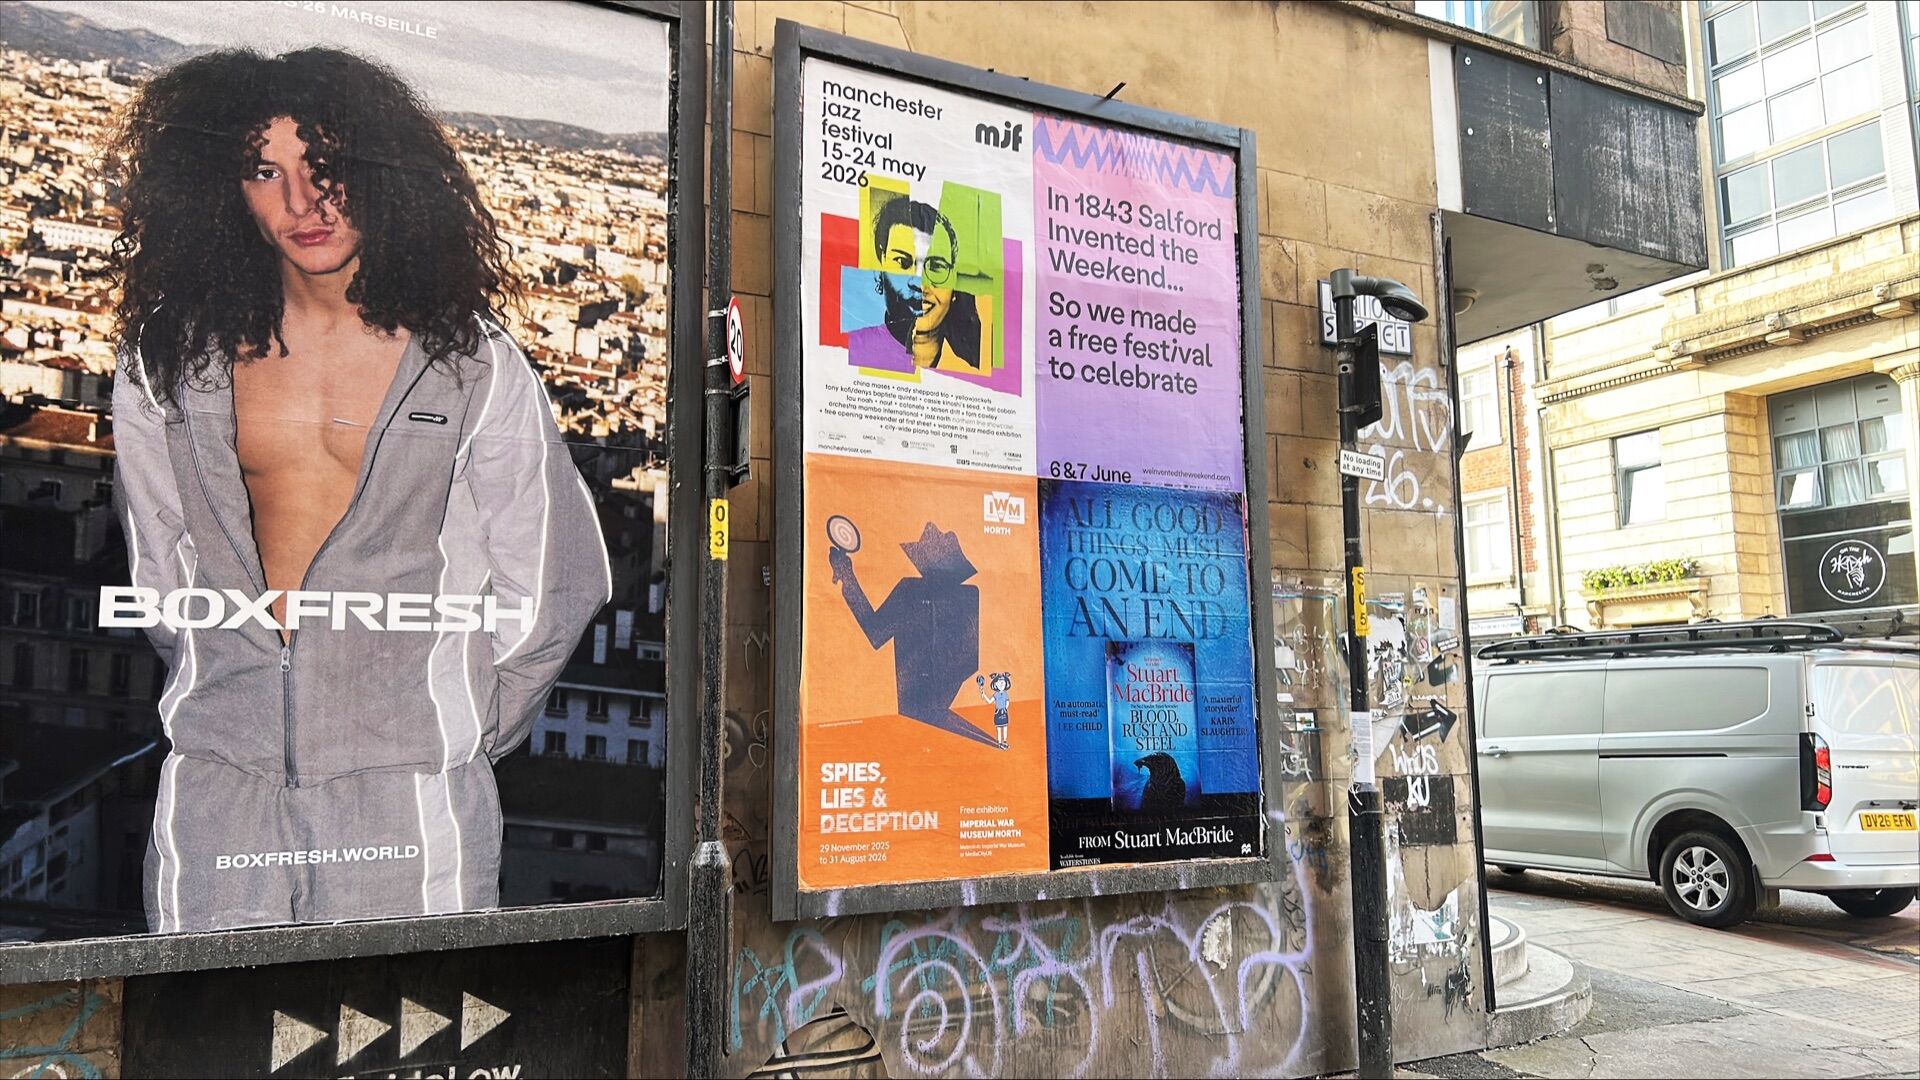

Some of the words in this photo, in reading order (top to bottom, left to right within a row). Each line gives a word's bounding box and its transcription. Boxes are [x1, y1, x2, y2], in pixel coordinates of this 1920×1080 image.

[331, 5, 438, 39] MARSEILLE
[822, 80, 943, 120] manchester
[822, 97, 861, 122] jazz
[822, 118, 892, 150] festival
[975, 121, 1023, 152] mjf
[822, 139, 876, 168] 15-24
[882, 157, 926, 181] may
[821, 162, 869, 187] 2026
[1048, 186, 1069, 213] In
[1075, 193, 1133, 225] 1843
[1138, 204, 1222, 241] Salford
[1048, 217, 1155, 258] Invented
[1160, 238, 1199, 265] the
[1048, 247, 1184, 292] Weekend...
[1049, 291, 1081, 319] So
[1087, 303, 1124, 325] we
[1131, 309, 1197, 336] made
[731, 318, 743, 362] 20
[1048, 328, 1062, 348] a
[1068, 324, 1117, 355] free
[1123, 332, 1213, 368] festival
[1048, 356, 1075, 380] to
[1081, 361, 1198, 395] celebrate
[825, 384, 839, 392] tony
[873, 390, 897, 400] baptiste
[898, 394, 918, 402] quintet
[896, 386, 911, 394] andy
[913, 387, 939, 397] sheppard
[955, 394, 992, 404] yellowjackets
[828, 401, 857, 410] orchestra
[858, 404, 881, 413] mambo
[883, 407, 918, 417] international
[825, 408, 836, 416] free
[838, 410, 863, 420] opening
[864, 413, 897, 423] weekender
[917, 419, 932, 427] street
[938, 423, 958, 431] women
[977, 428, 994, 436] media
[996, 430, 1022, 439] exhibition
[912, 428, 929, 436] piano
[942, 431, 952, 439] and
[1343, 453, 1354, 462] No
[1356, 456, 1381, 469] loading
[1352, 465, 1364, 475] any
[1366, 467, 1381, 477] time
[1091, 465, 1132, 484] June
[1142, 467, 1231, 481] weinventedtheweekend.com
[988, 498, 1021, 517] IWM
[1066, 496, 1122, 529] ALL
[1131, 502, 1223, 535] GOOD
[983, 525, 1011, 536] NORTH
[1067, 530, 1149, 557] THINGS
[1163, 537, 1224, 559] MUST
[1064, 556, 1171, 594] COME
[1179, 563, 1225, 596] TO
[98, 585, 535, 633] BOXFRESH
[1066, 596, 1129, 639] AN
[1140, 598, 1227, 640] END
[1127, 663, 1179, 683] Stuart
[1112, 683, 1195, 703] MacBride
[1210, 694, 1242, 703] masterful
[1075, 722, 1103, 731] CHILD
[1130, 709, 1180, 725] BLOOD,
[1211, 716, 1236, 725] KARIN
[1122, 723, 1160, 738] RUST
[1160, 722, 1188, 737] AND
[1135, 737, 1176, 751] STEEL
[820, 762, 887, 784] SPIES,
[820, 788, 865, 809] LIES
[871, 788, 887, 808] &
[960, 805, 976, 814] Free
[976, 805, 1009, 814] exhibition
[820, 811, 939, 834] DECEPTION
[960, 819, 996, 828] IMPERIAL
[997, 818, 1015, 827] WAR
[1864, 814, 1891, 828] DV26
[1892, 813, 1913, 827] EFN
[960, 830, 995, 839] MUSEUM
[995, 829, 1021, 838] NORTH
[1079, 835, 1111, 849] FROM
[1114, 829, 1162, 849] Stuart
[1165, 825, 1234, 846] MacBride
[820, 844, 830, 853] 29
[831, 842, 870, 852] November
[871, 841, 890, 850] 2025
[215, 845, 419, 870] BOXFRESH.WORLD
[819, 856, 828, 865] to
[829, 855, 838, 864] 31
[840, 854, 867, 865] August
[868, 853, 887, 862] 2026
[1060, 857, 1101, 867] WATERSTONES
